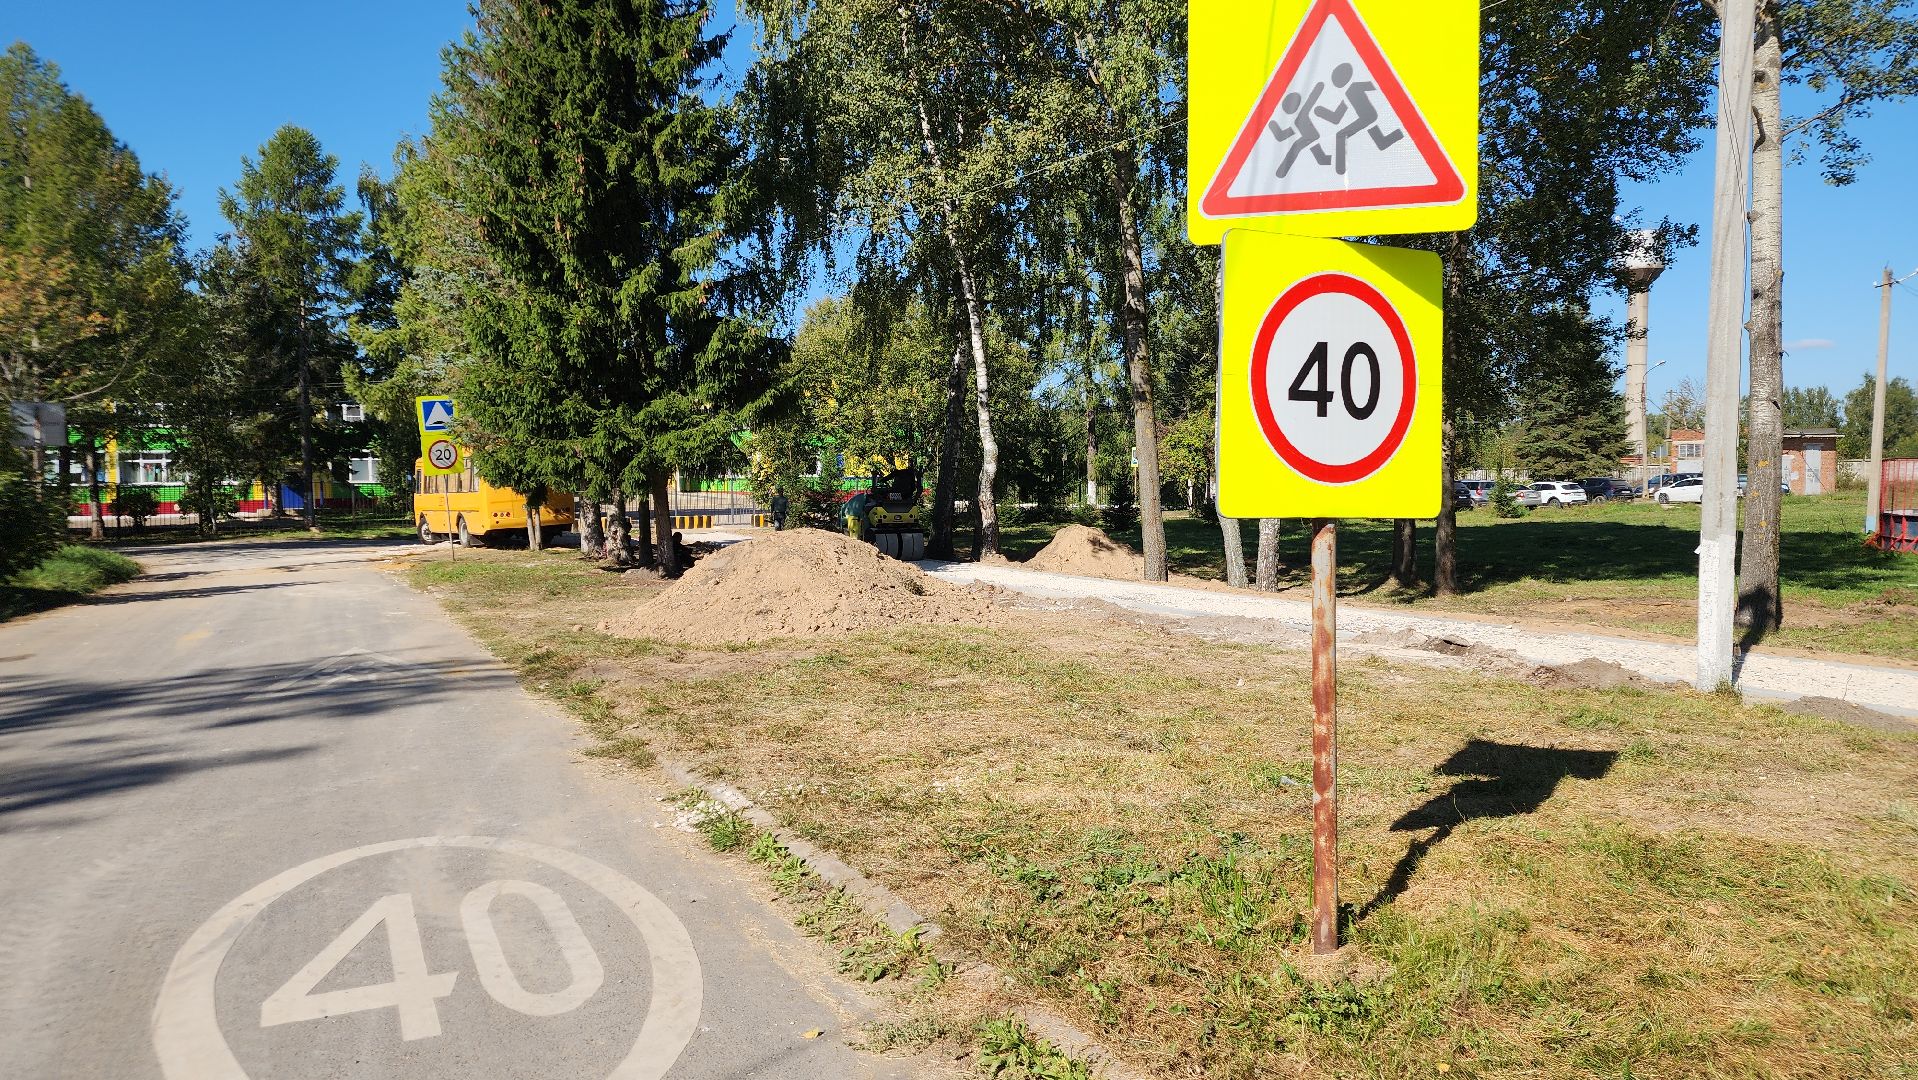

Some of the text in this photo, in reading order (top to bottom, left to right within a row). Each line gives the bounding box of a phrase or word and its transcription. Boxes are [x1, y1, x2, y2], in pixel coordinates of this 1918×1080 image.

[1288, 341, 1381, 420] 40
[435, 448, 451, 460] 20
[259, 879, 605, 1042] 40
